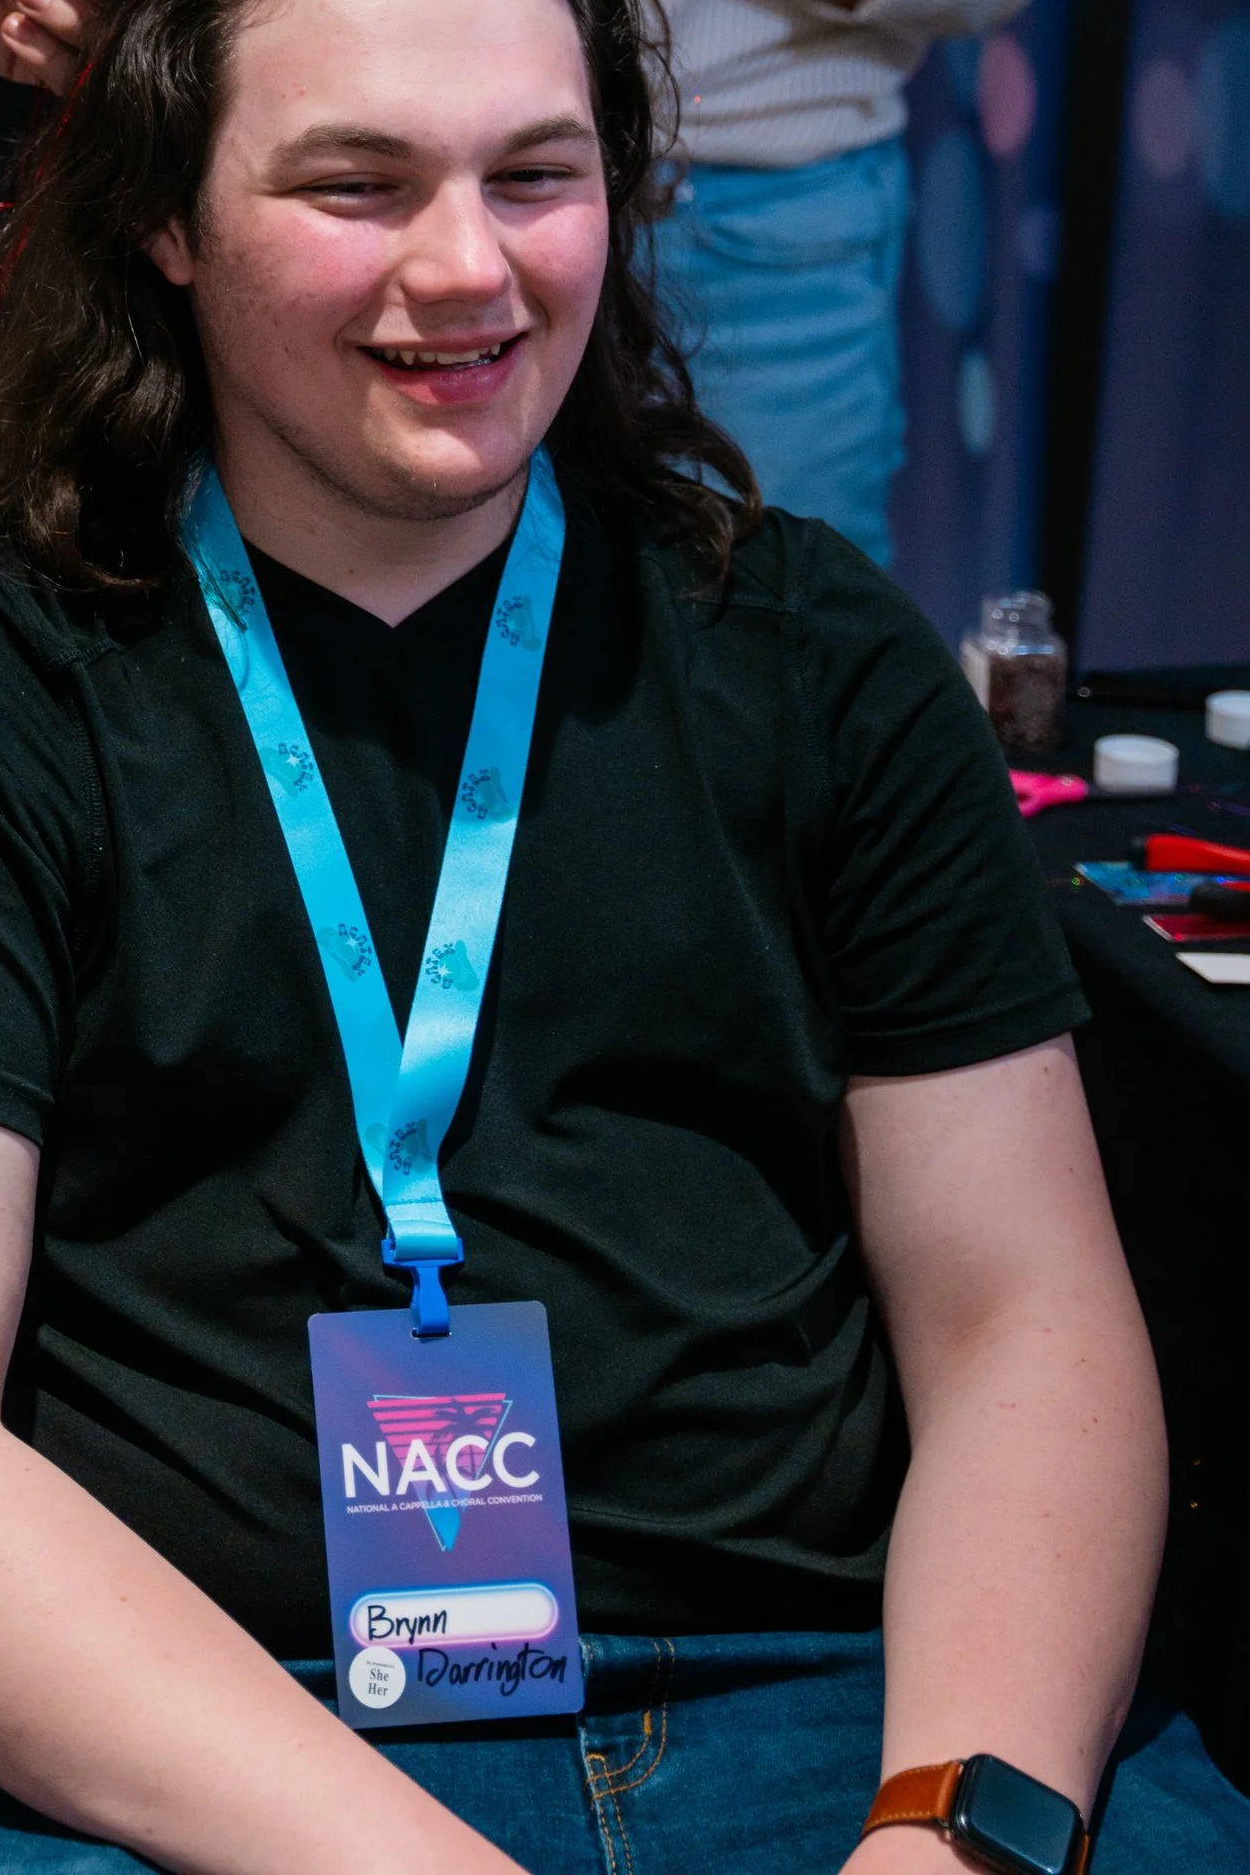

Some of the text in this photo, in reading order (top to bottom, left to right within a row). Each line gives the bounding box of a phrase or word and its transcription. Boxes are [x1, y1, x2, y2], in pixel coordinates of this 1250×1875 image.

[341, 1431, 541, 1498] NACC
[346, 1503, 390, 1514] NATIONAL
[391, 1503, 398, 1511] A
[399, 1500, 443, 1511] CAPPELLA
[450, 1497, 486, 1507] CHORAL
[487, 1493, 543, 1505] CONVENTION
[367, 1605, 448, 1645] Brynn
[369, 1668, 389, 1682] She
[417, 1641, 568, 1697] Darrington
[368, 1682, 389, 1696] Her
